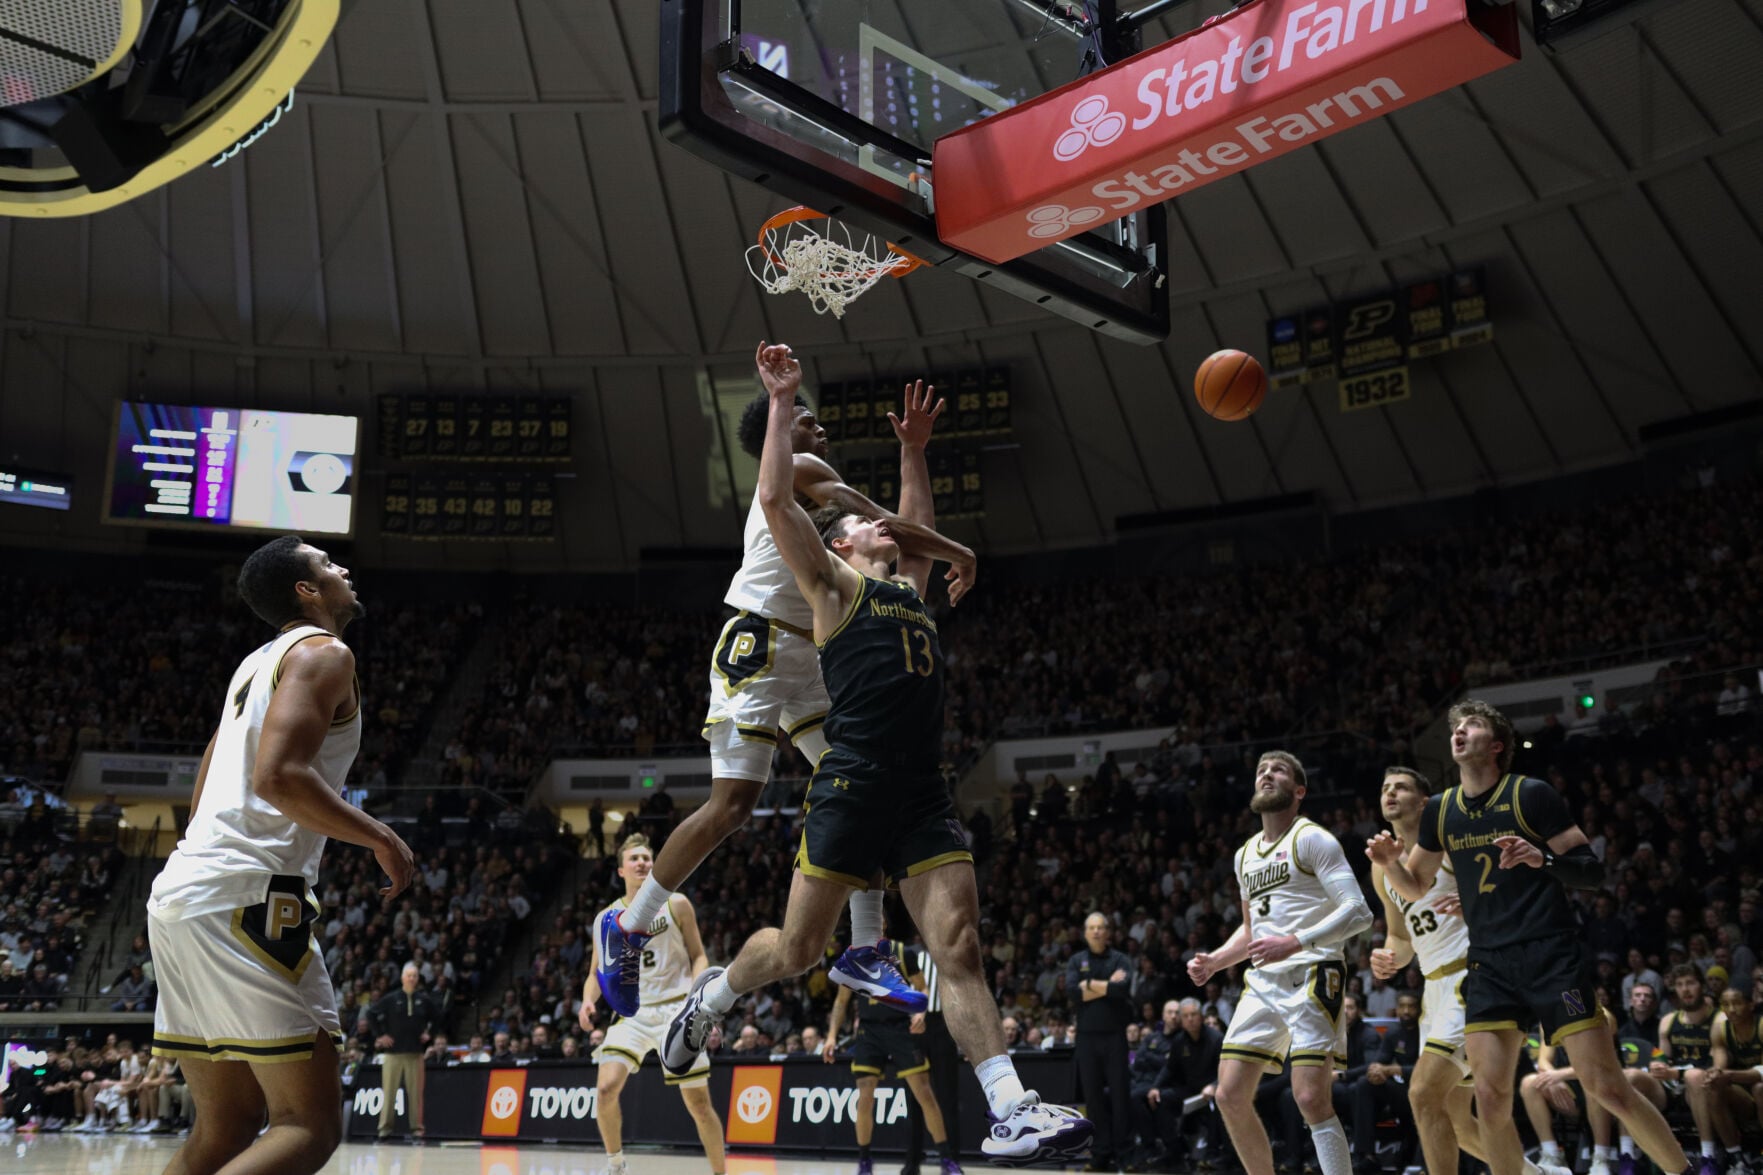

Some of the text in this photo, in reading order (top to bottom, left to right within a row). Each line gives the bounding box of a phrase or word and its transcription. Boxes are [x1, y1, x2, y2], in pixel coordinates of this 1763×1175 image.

[1344, 373, 1405, 405] 1932
[405, 419, 429, 436] 27
[436, 419, 456, 436] 13
[468, 419, 480, 436] 7
[490, 419, 513, 437] 23
[519, 419, 542, 437] 37
[550, 419, 569, 438] 19
[384, 495, 409, 513] 32
[415, 497, 438, 514] 35
[443, 497, 467, 515] 43
[472, 497, 496, 516] 42
[504, 498, 522, 516] 10
[530, 498, 553, 516] 22
[728, 631, 757, 665] P
[900, 625, 934, 677] 13
[1474, 852, 1497, 895] 2
[1258, 895, 1271, 916] 3
[265, 891, 302, 940] P
[1410, 910, 1438, 937] 23
[643, 950, 656, 969] 2
[1324, 968, 1341, 1000] P
[1561, 988, 1586, 1017] N
[353, 1087, 405, 1116] YOA
